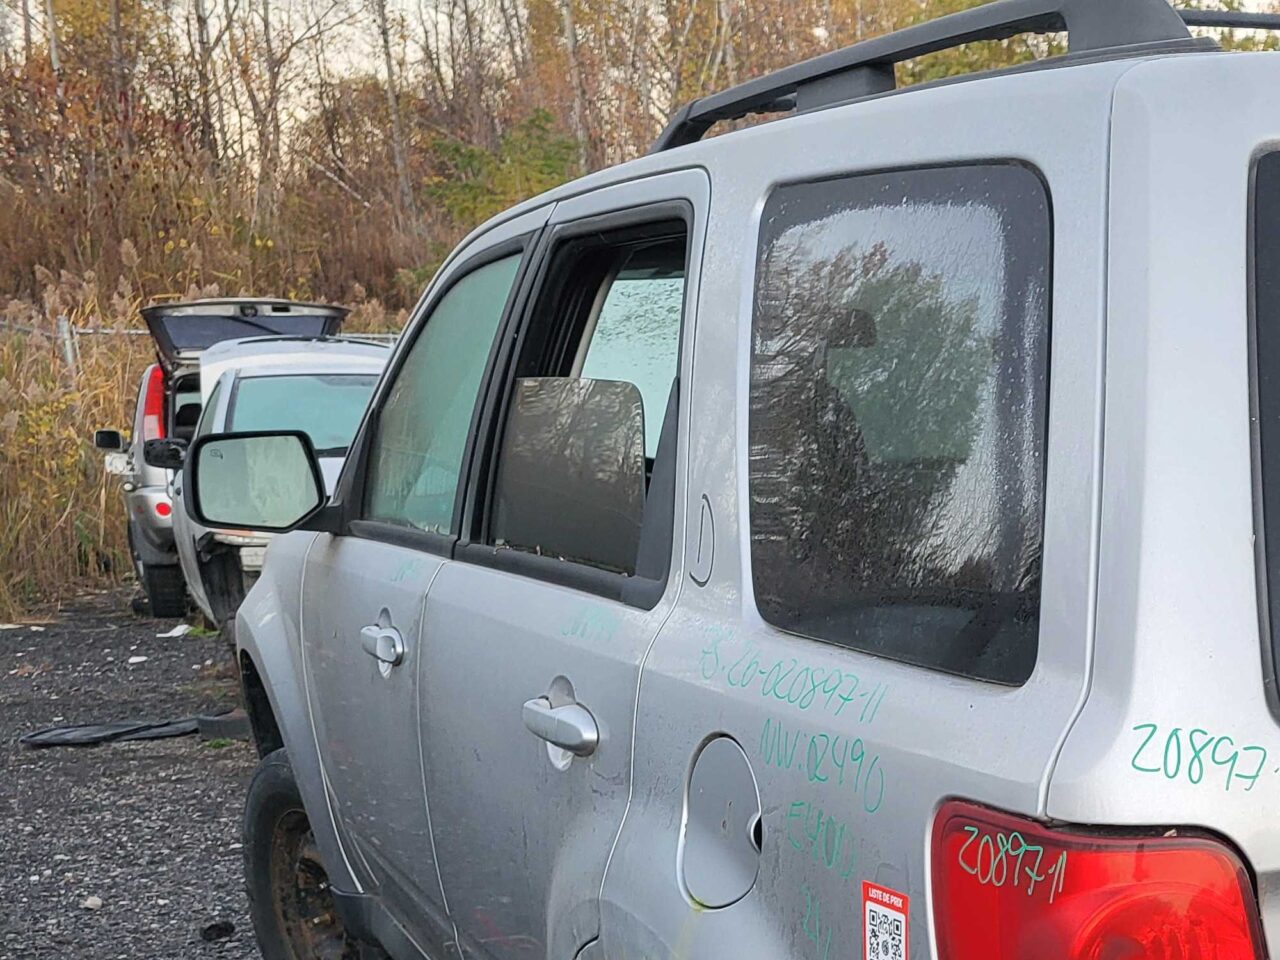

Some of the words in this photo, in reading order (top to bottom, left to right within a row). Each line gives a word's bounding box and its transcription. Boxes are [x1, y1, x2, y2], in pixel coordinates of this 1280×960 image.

[868, 886, 883, 901] LISTE
[883, 892, 891, 904] DE
[890, 895, 904, 909] PRIX
